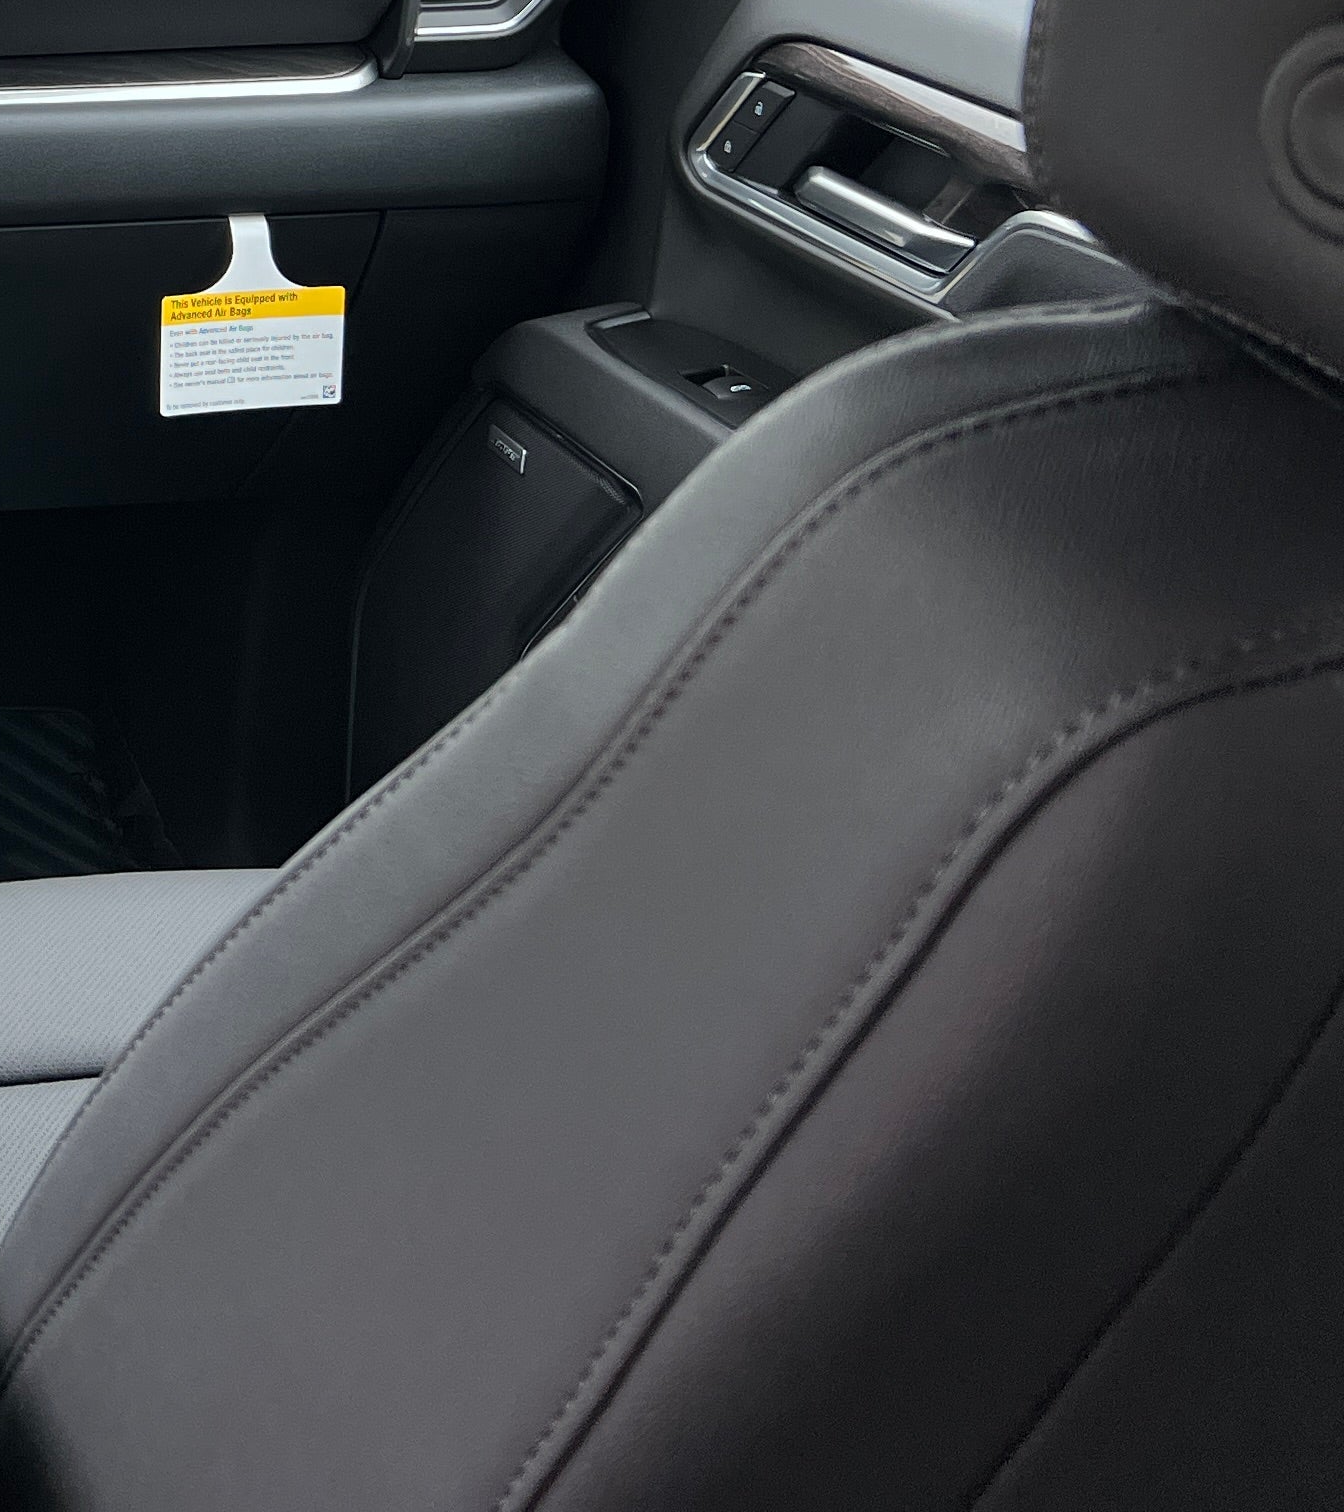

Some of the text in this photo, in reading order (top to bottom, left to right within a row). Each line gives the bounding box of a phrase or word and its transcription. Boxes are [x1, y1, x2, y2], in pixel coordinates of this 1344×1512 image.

[171, 300, 188, 309] This
[191, 298, 222, 308] Vehicle
[235, 293, 276, 306] Equipped
[279, 292, 298, 301] with
[170, 307, 251, 320] Advanced Air Bags
